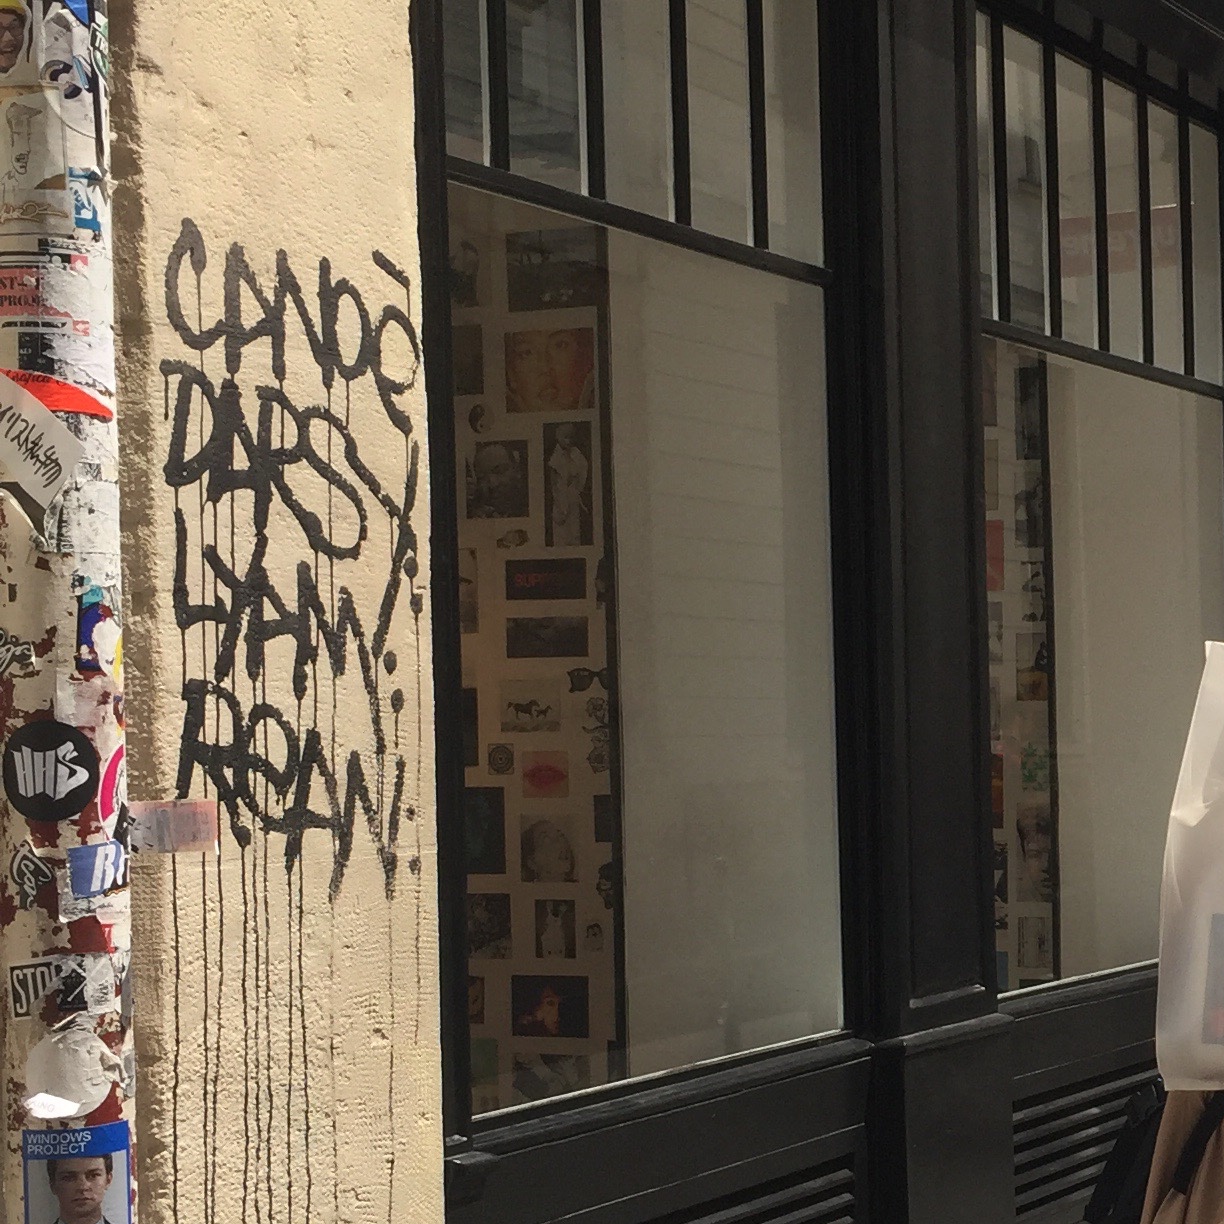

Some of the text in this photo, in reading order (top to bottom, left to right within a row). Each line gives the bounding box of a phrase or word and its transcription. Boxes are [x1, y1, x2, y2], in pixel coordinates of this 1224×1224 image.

[13, 961, 60, 1014] STO
[26, 1131, 92, 1144] WINDOWS
[27, 1142, 87, 1156] PROJECT
